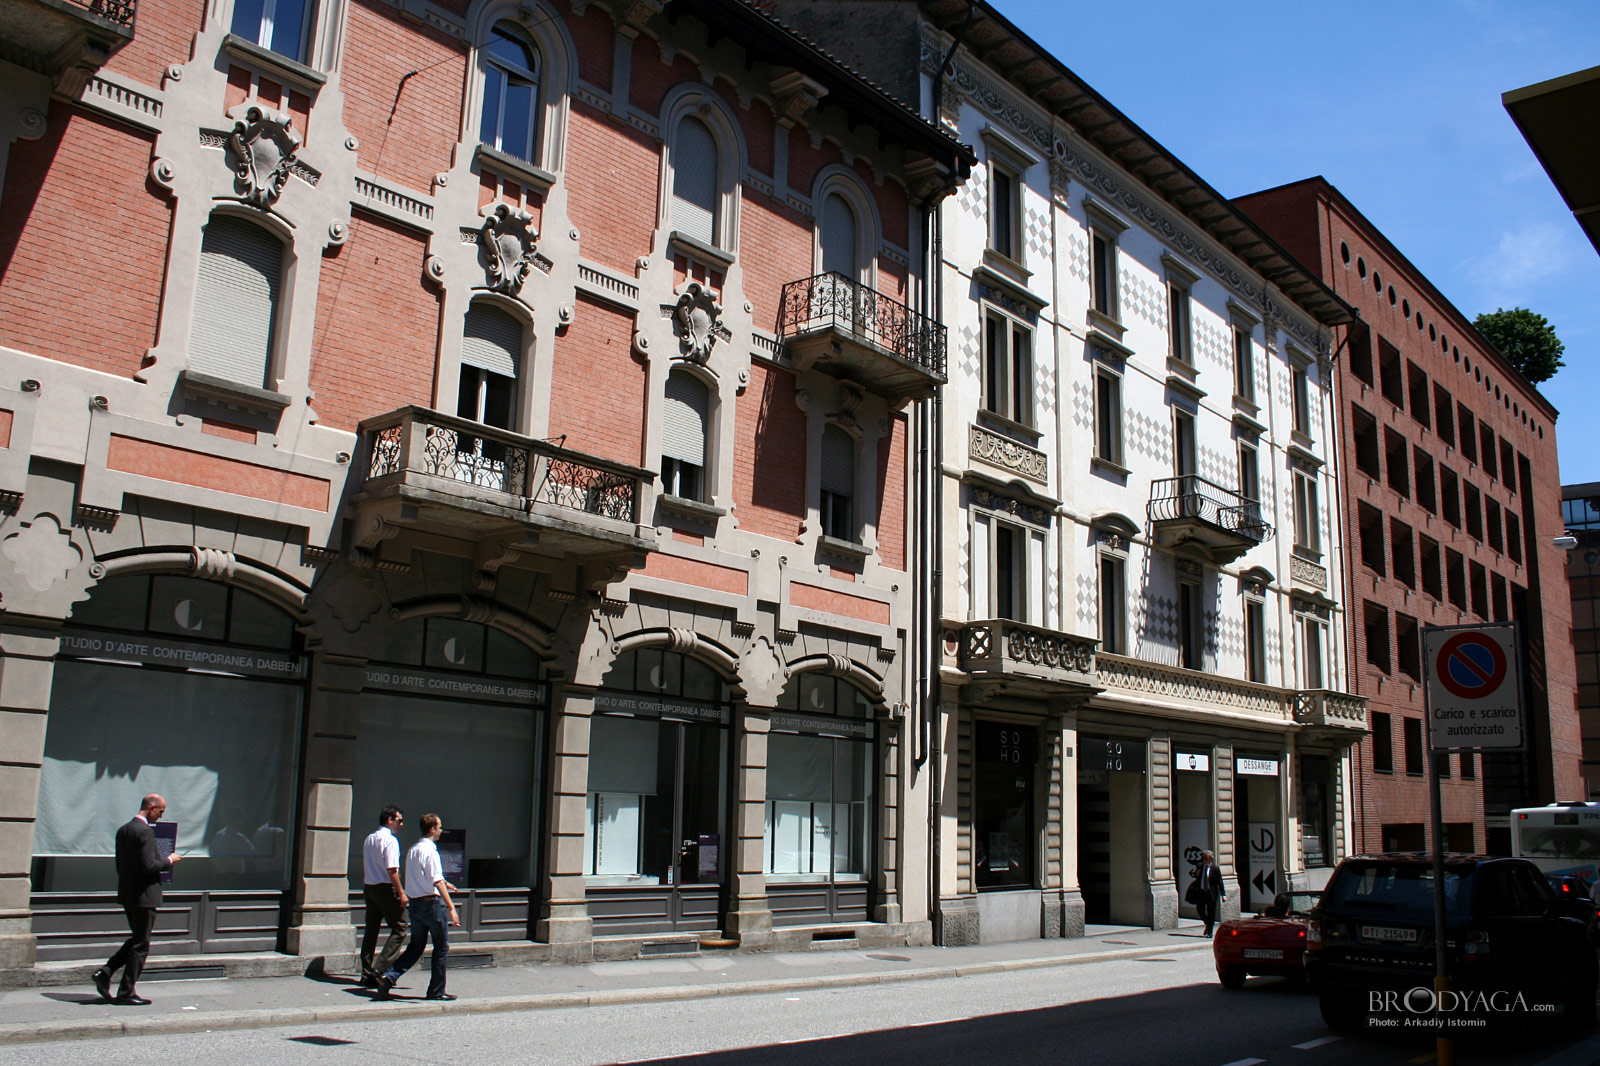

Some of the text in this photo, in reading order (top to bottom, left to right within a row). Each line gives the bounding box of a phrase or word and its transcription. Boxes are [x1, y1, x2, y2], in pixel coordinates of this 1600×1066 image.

[106, 641, 149, 656] D'ARTE
[153, 646, 253, 668] CONTEMPORANEA
[257, 658, 301, 673] DABBENI
[365, 671, 390, 683] UDIO
[392, 674, 425, 687] D'ARTE
[428, 678, 505, 696] CONTEMPORANEA
[611, 698, 637, 709] D'ARTE
[639, 701, 699, 716] CONTEMPORANEA
[1434, 706, 1516, 720] Carico e scarico
[801, 719, 849, 732] CONTEMPORANEA
[1447, 723, 1504, 736] autorizzato
[1243, 759, 1272, 771] DESSANGE
